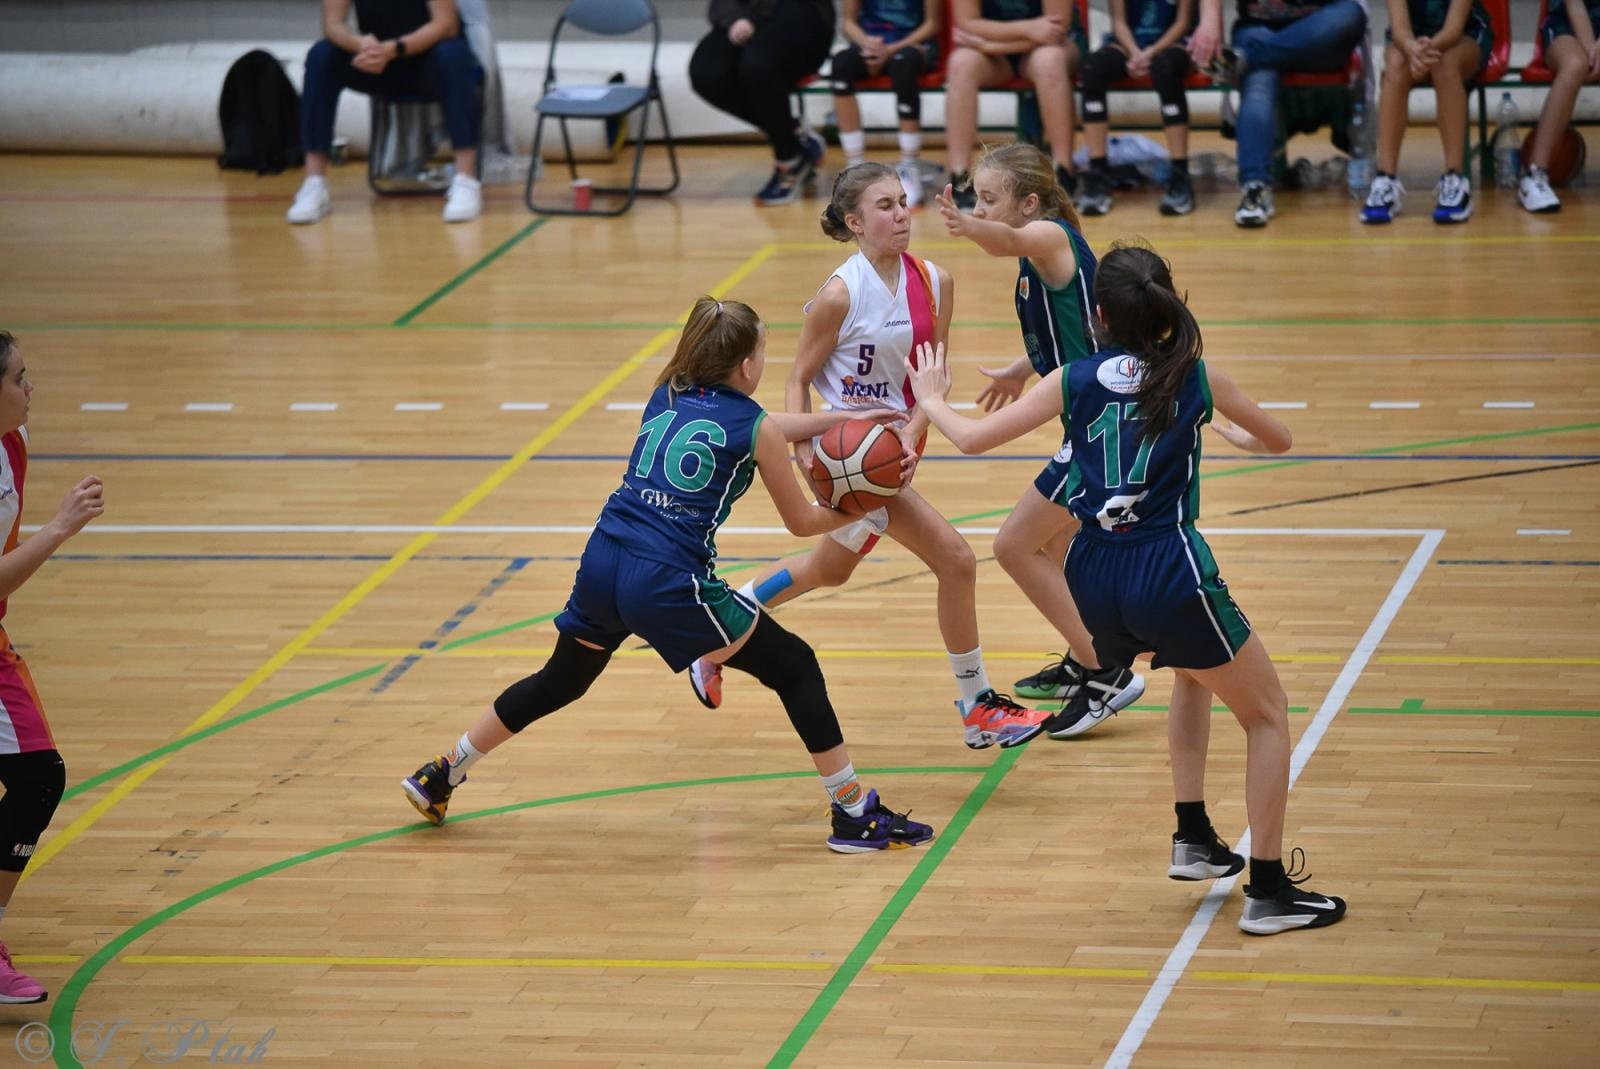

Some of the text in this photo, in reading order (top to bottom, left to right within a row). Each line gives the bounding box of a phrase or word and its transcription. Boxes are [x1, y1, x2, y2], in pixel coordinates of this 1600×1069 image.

[857, 344, 875, 376] 5
[636, 409, 727, 492] 16
[1087, 401, 1179, 488] 17
